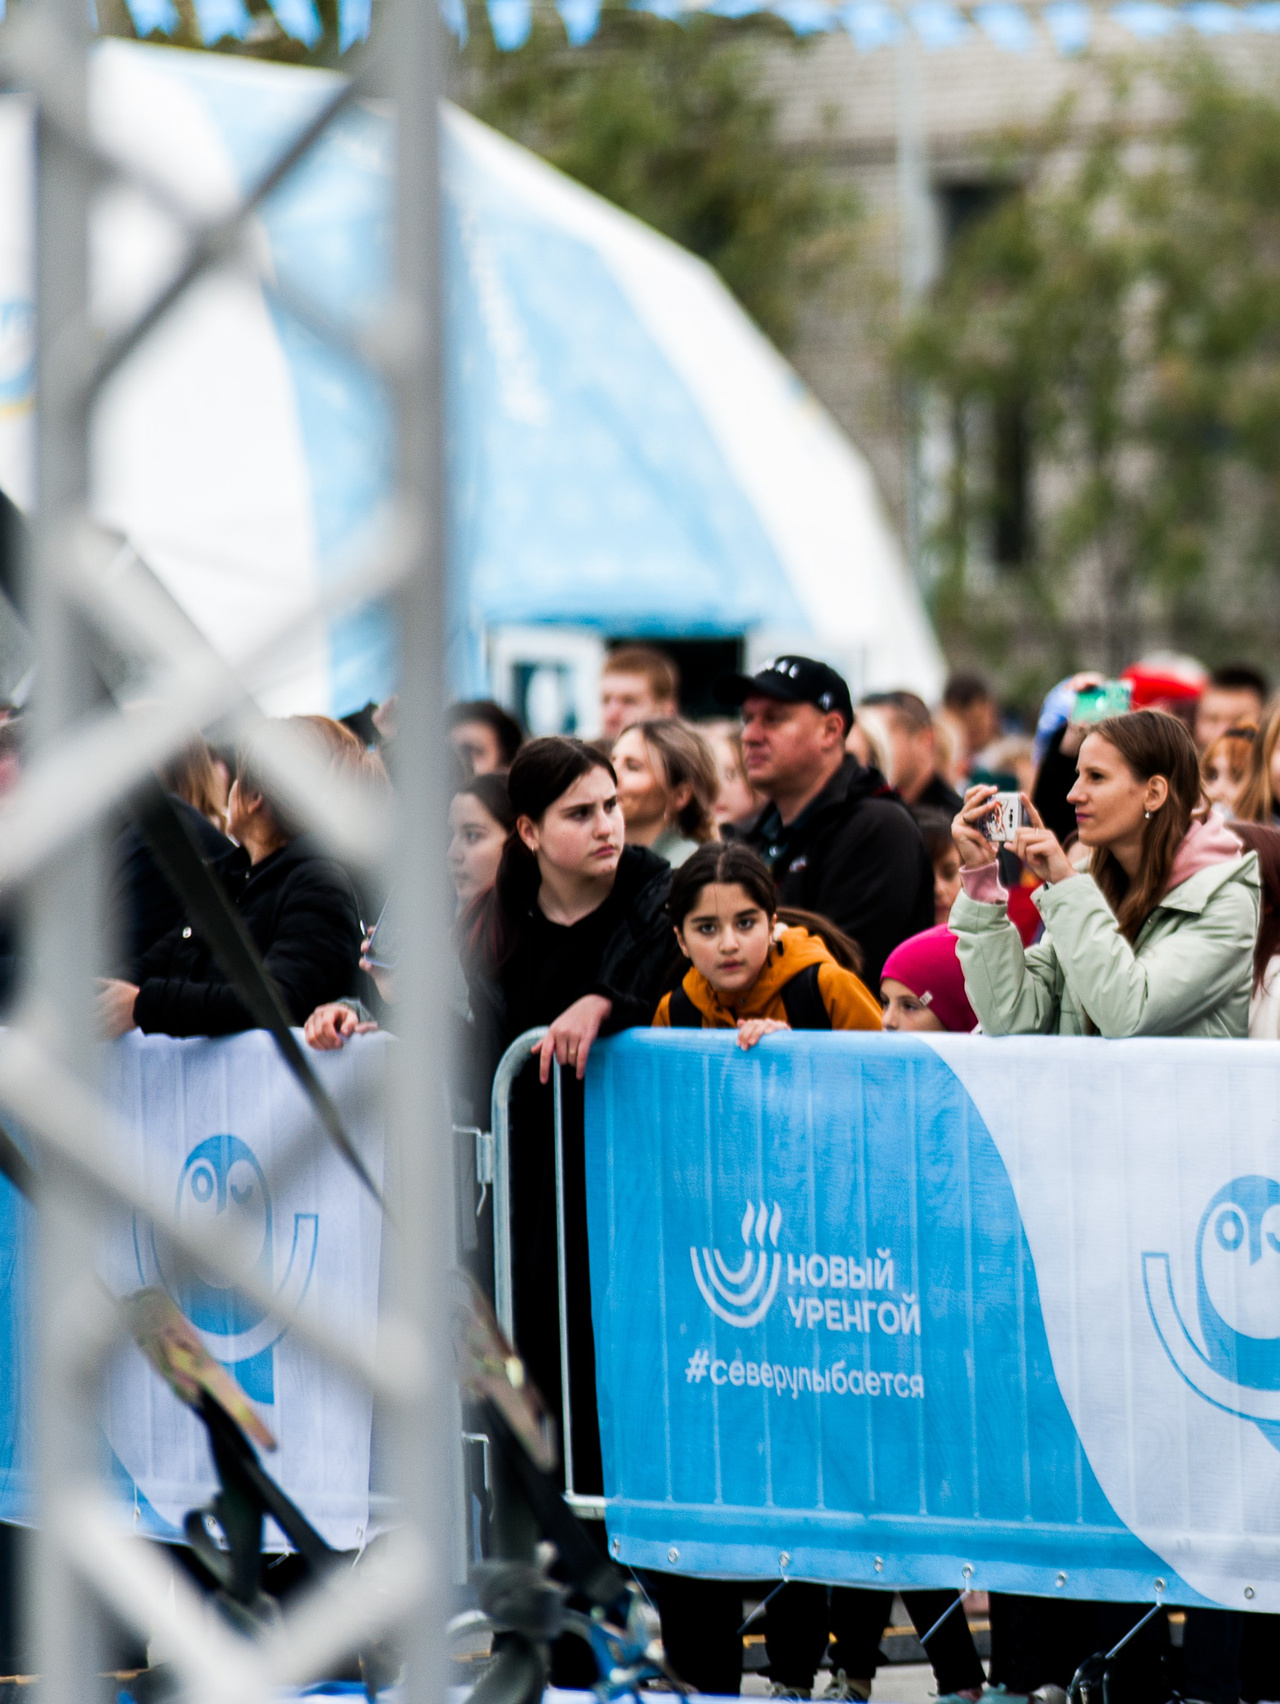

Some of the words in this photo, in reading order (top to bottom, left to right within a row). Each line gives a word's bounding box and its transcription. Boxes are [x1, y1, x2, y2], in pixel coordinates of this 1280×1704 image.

[786, 1247, 895, 1291] НОВЫЙ
[786, 1292, 922, 1336] УРЕНГОЙ
[684, 1348, 925, 1400] #северулыбается
